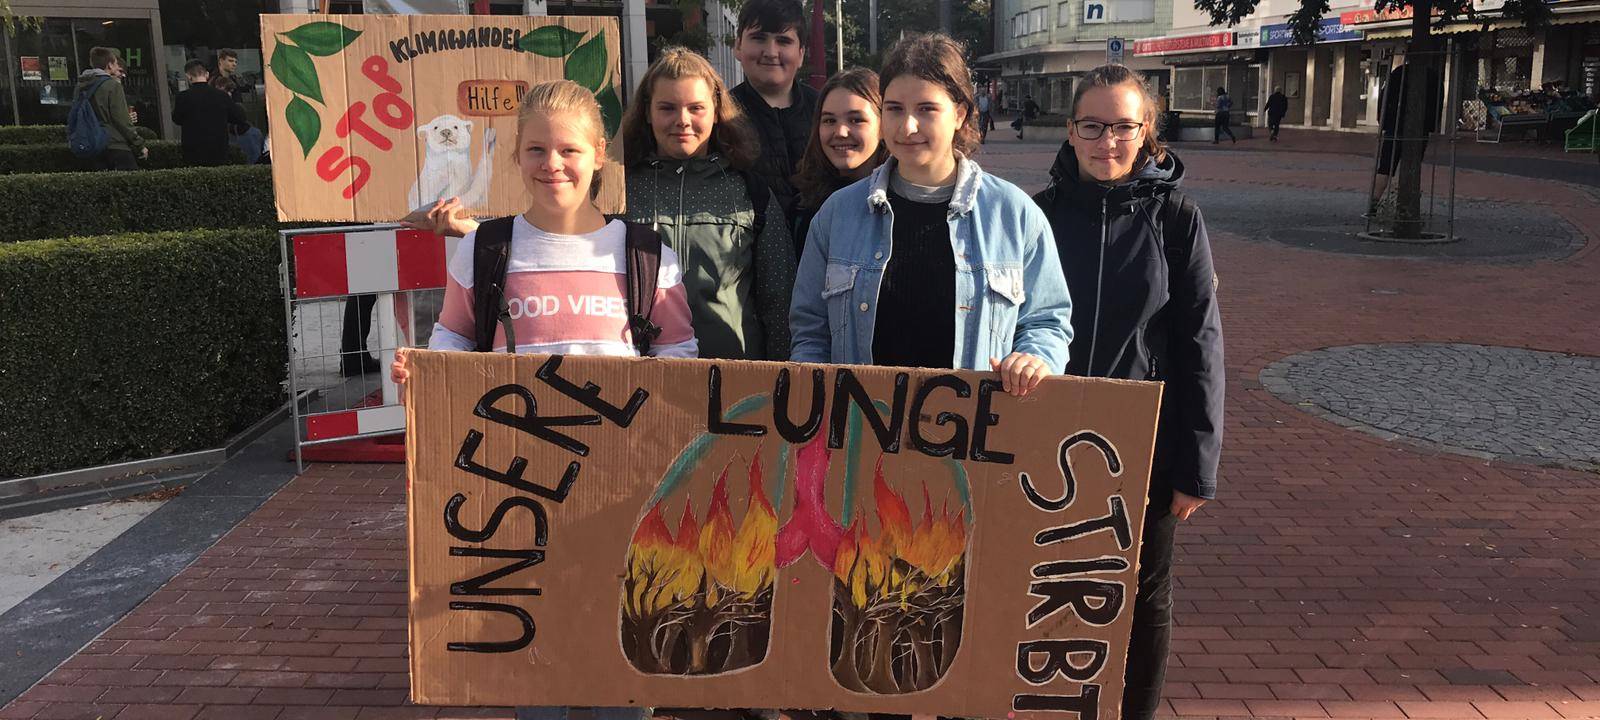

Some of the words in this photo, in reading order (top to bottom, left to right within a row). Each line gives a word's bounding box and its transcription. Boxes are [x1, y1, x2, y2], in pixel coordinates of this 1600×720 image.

[1087, 4, 1103, 19] n
[316, 55, 414, 200] STOP
[389, 27, 525, 63] KLIMAWANDEL
[508, 295, 560, 320] OOD
[444, 354, 650, 654] UNSERE
[708, 364, 1016, 465] LUNGE
[1012, 429, 1134, 720] STIRBT
